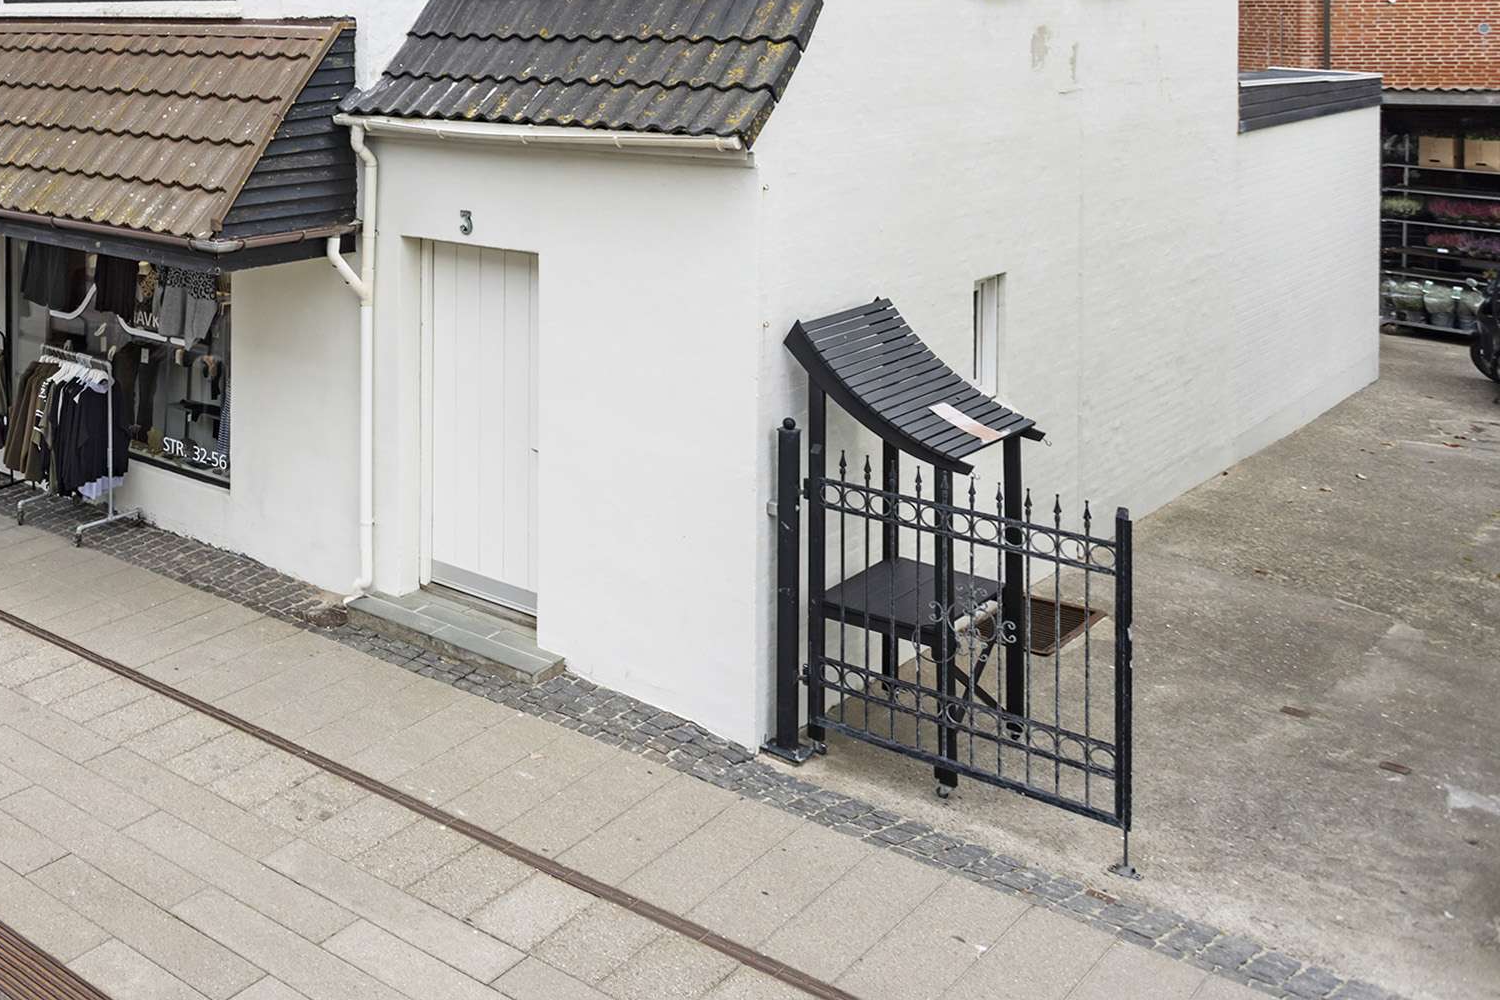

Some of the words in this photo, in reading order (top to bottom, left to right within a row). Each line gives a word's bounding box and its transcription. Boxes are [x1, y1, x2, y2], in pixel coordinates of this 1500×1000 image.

[459, 209, 473, 236] 3
[163, 436, 187, 458] STR.
[192, 445, 227, 470] 32-56
